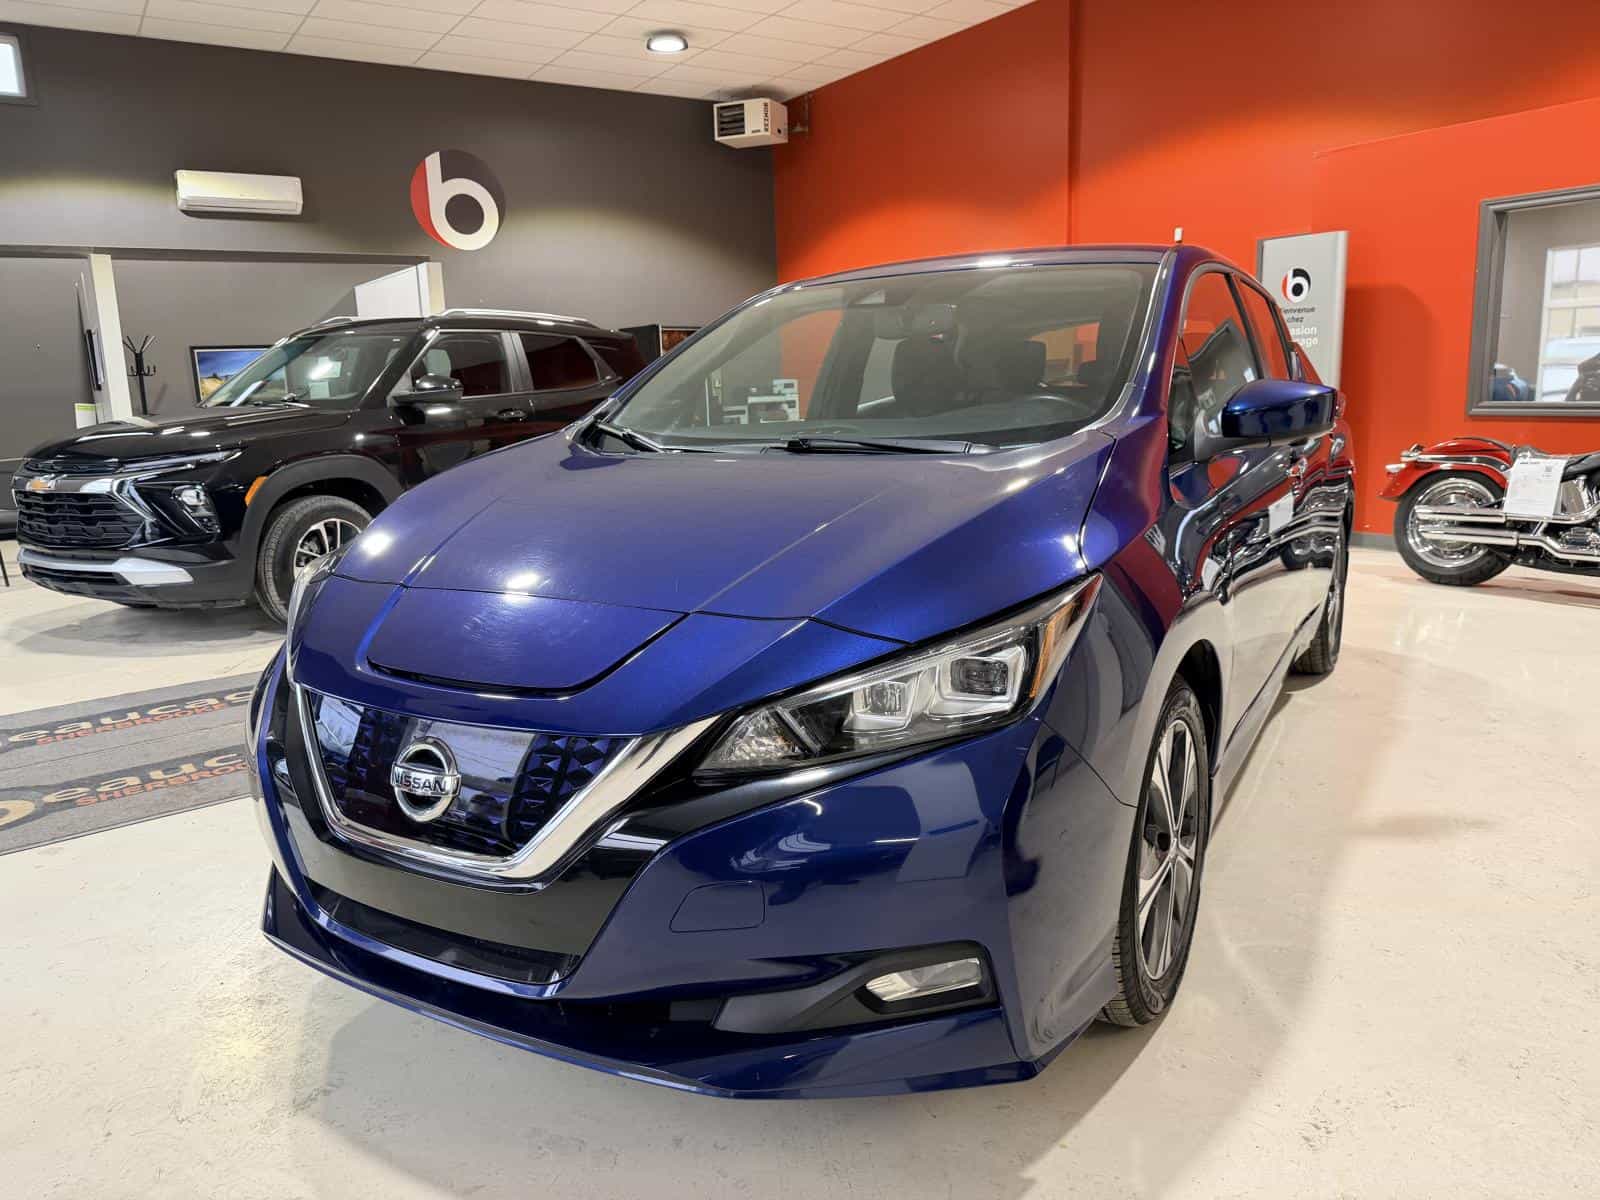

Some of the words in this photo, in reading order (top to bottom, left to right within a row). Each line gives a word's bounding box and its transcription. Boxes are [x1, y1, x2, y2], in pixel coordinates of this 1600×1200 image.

[425, 151, 499, 250] b
[1286, 267, 1309, 303] b
[392, 768, 446, 793] NISSAN
